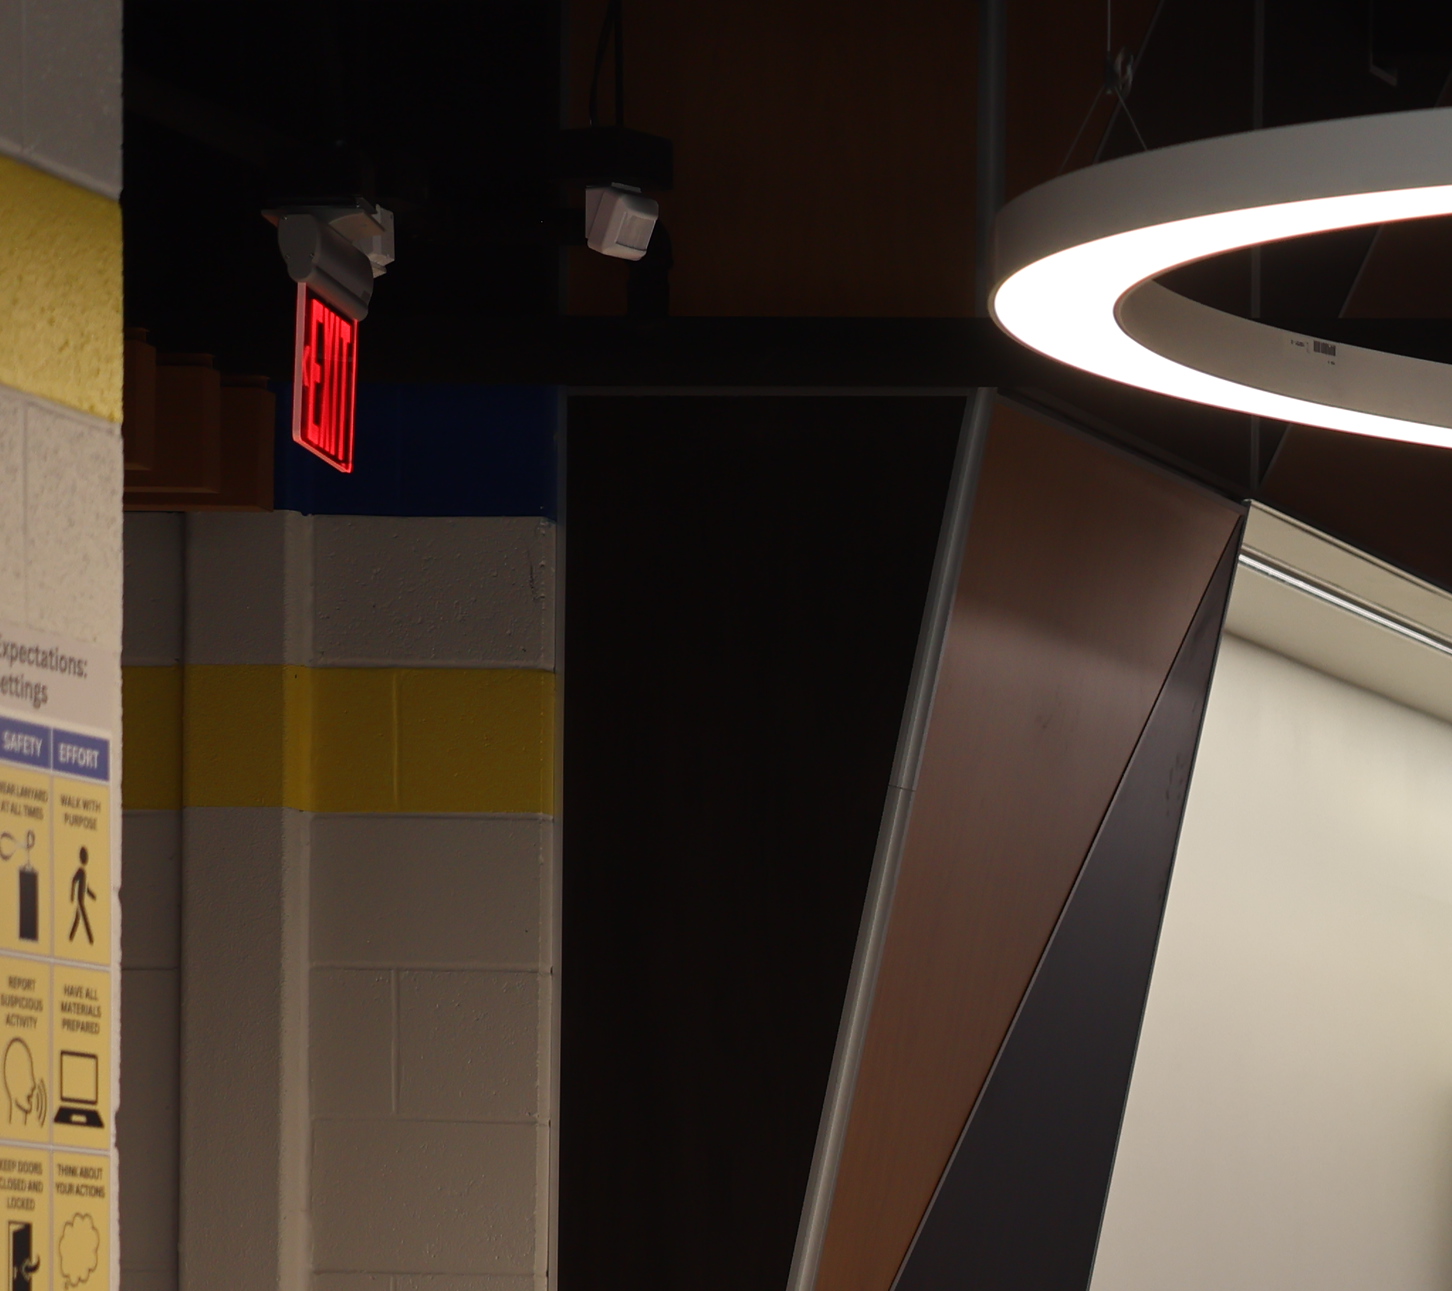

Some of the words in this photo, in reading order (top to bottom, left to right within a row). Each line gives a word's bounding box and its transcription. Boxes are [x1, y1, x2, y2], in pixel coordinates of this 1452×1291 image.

[307, 298, 352, 461] EXIT
[0, 640, 88, 679] xpectations:
[0, 673, 48, 709] ettings
[2, 730, 43, 758] SAFETY
[58, 742, 99, 769] EFFORT
[8, 975, 36, 992] REPORT
[63, 984, 83, 1000] HAVE
[85, 987, 98, 1002] ALL
[60, 1001, 102, 1019] MATERIALS
[62, 1018, 100, 1036] PREPARED
[57, 1163, 78, 1178] THINK
[79, 1165, 103, 1181] ABOUT
[55, 1181, 75, 1196] YOUR
[75, 1184, 105, 1200] ACTIONS
